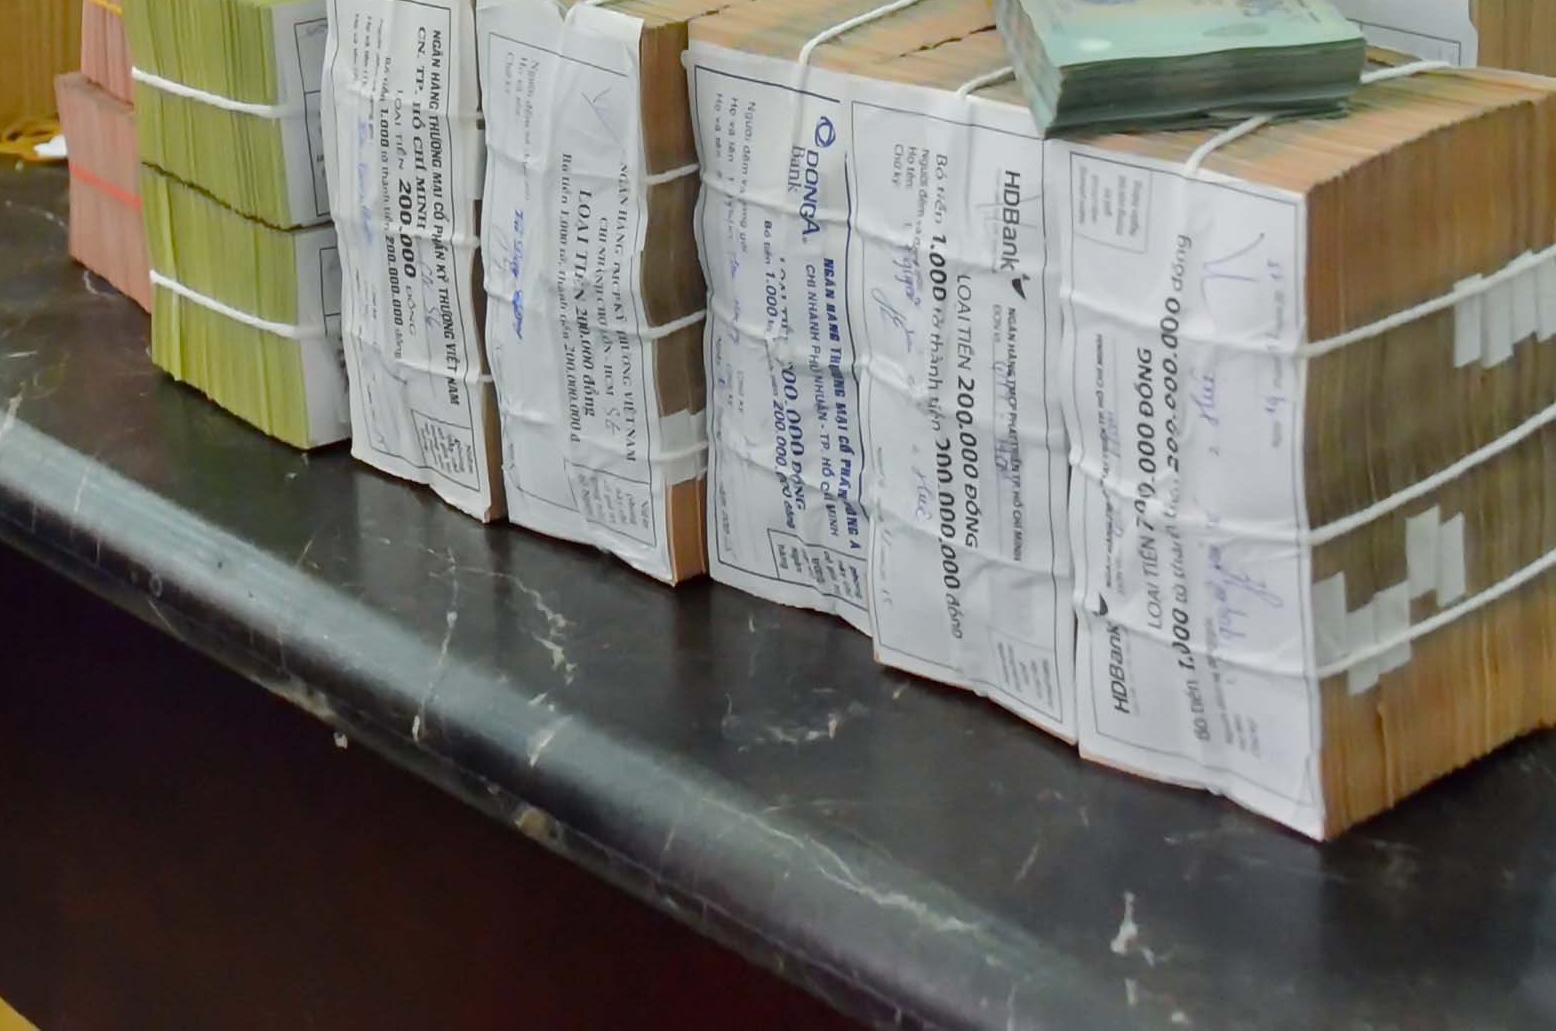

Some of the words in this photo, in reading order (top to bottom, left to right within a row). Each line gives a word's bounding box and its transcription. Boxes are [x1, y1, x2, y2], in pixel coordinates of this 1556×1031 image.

[429, 114, 443, 168] THƯƠNG
[787, 145, 805, 193] Bank
[380, 107, 390, 147] 1.000
[385, 234, 403, 326] 200.000.000
[398, 178, 417, 279] 200.000
[415, 176, 428, 229] MINH
[1000, 169, 1021, 272] HDBank
[765, 271, 779, 317] 1.000
[805, 264, 816, 287] CHI
[929, 234, 948, 301] 1.000
[439, 288, 456, 339] THƯƠNG
[955, 275, 972, 322] LOẠI
[576, 305, 594, 369] 200.000
[928, 333, 944, 390] thành
[957, 326, 976, 371] TIỀN
[447, 377, 460, 406] NAM
[564, 343, 581, 430] 200.000.000
[603, 365, 614, 396] HCM
[1133, 347, 1154, 419] ĐỒNG
[1160, 297, 1181, 474] 200.000.000
[835, 402, 847, 430] MẠI
[955, 375, 979, 479] 200.000
[625, 429, 637, 462] NAM
[964, 483, 982, 548] ĐỒNG
[1137, 534, 1160, 578] TIỀN
[1145, 583, 1164, 630] LOẠI
[1170, 608, 1196, 671] 1.000
[1106, 622, 1130, 715] HDBank
